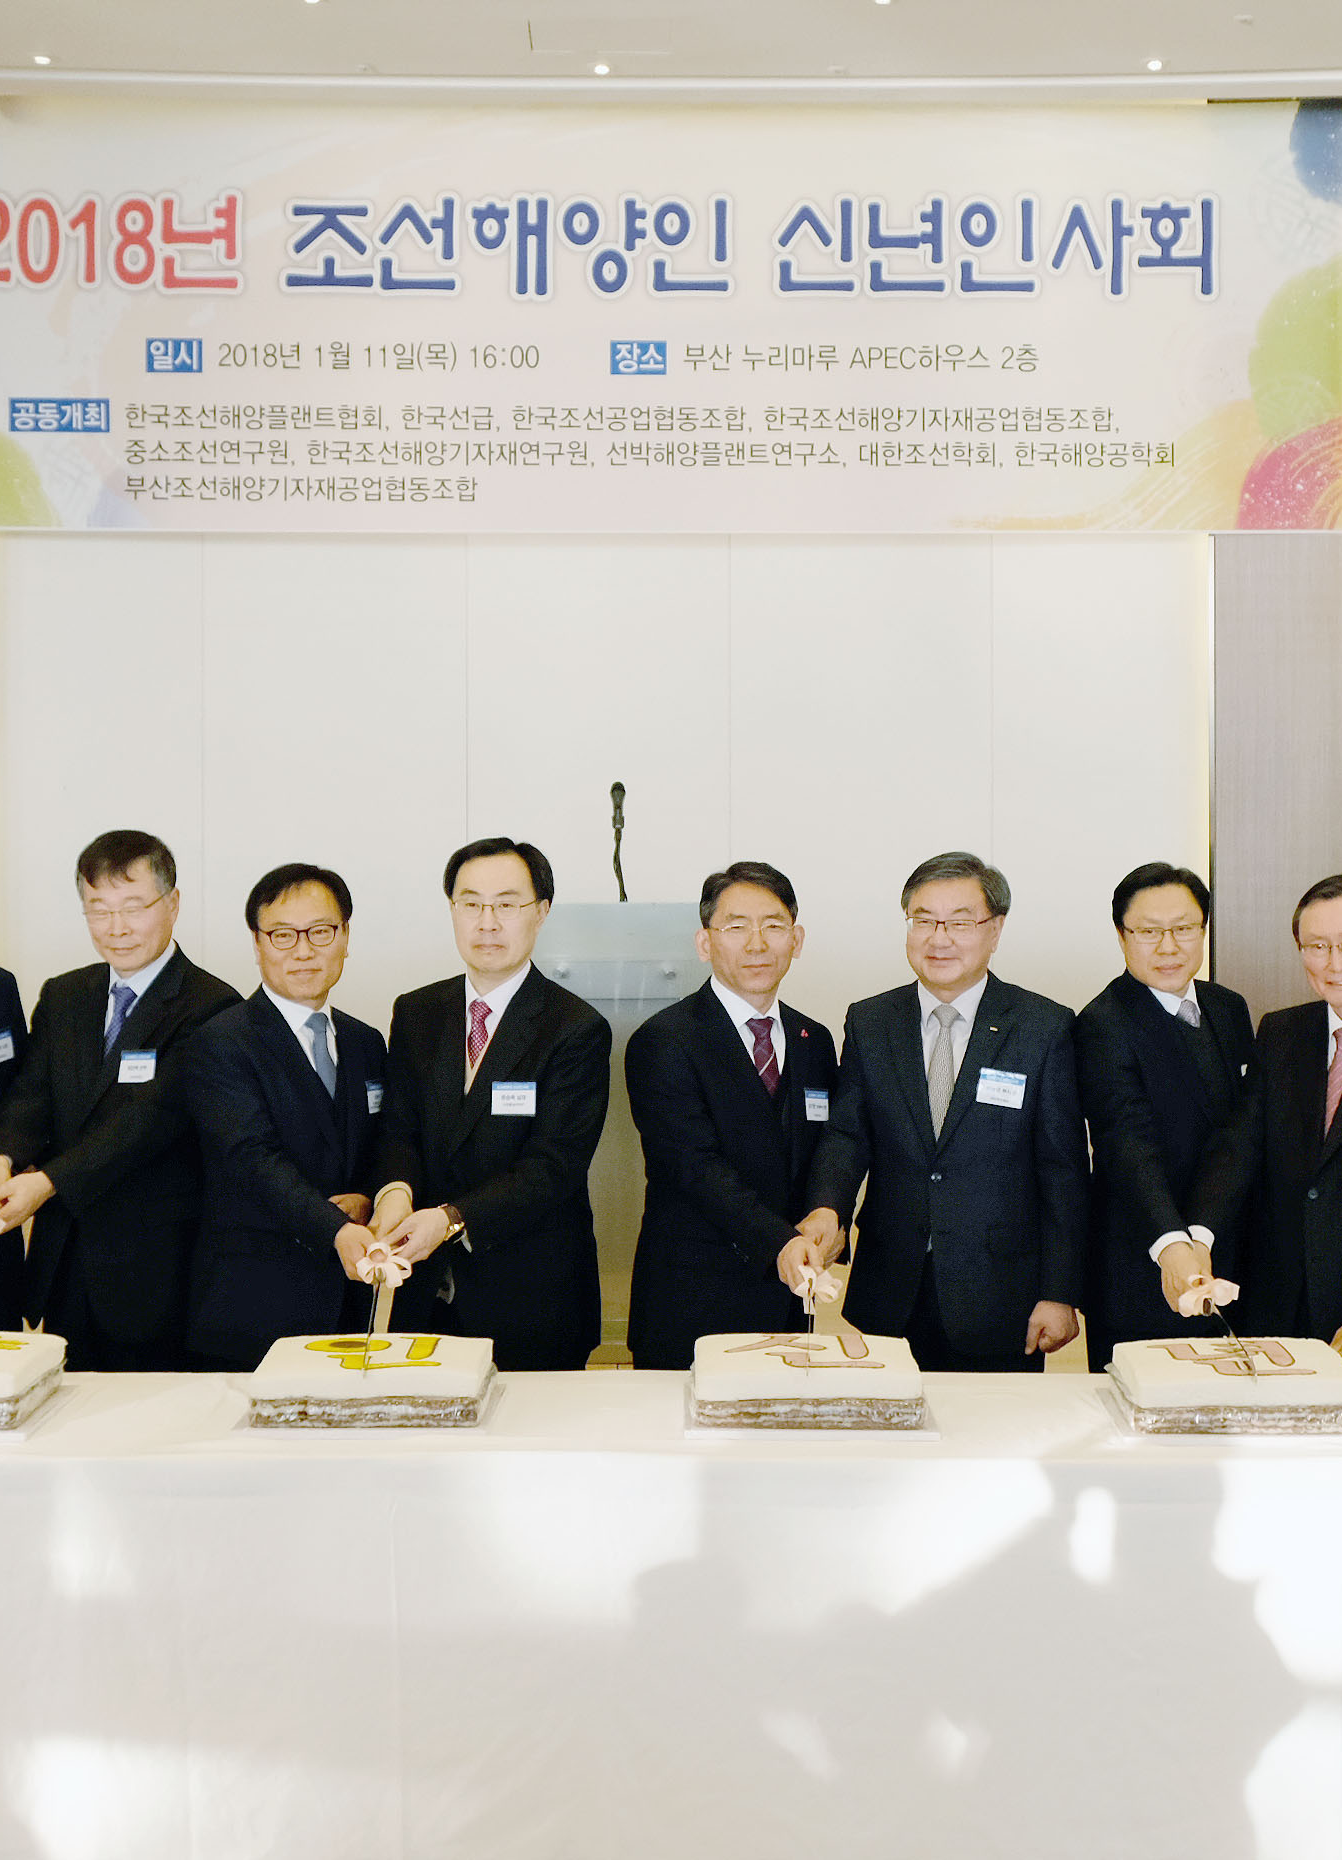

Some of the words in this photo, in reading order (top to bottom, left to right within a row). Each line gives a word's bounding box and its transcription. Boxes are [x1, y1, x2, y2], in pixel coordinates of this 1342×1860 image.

[284, 195, 731, 297] 조선해양인
[777, 195, 1215, 297] 신년인사회
[148, 340, 202, 371] 일시
[218, 342, 301, 370] 2018년
[314, 341, 351, 371] 1월
[363, 342, 458, 373] 11일(목)
[469, 344, 540, 369] 16:00
[614, 343, 666, 373] 장소
[682, 343, 733, 373] 부산
[741, 343, 840, 373] 누리마루
[848, 343, 991, 373] APEC하우스
[1000, 343, 1040, 373] 2층
[11, 402, 108, 431] 공동개최
[124, 403, 390, 433] 한국조선해양플랜트협회,
[401, 404, 501, 433] 한국선급,
[511, 405, 753, 433] 한국조선공업협동조합,
[762, 405, 1120, 434] 한국조선해양기자재공업협동조합,
[123, 439, 296, 467] 중소조선연구원,
[306, 439, 595, 468] 한국조선해양기자재연구원,
[606, 440, 847, 469] 선박해양플랜트연구소,
[858, 440, 1004, 469] 대한조선학회,
[1014, 440, 1175, 469] 한국해양공학회
[123, 475, 479, 503] 부산조선해양기자재공업협동조합
[304, 1336, 443, 1370] 인
